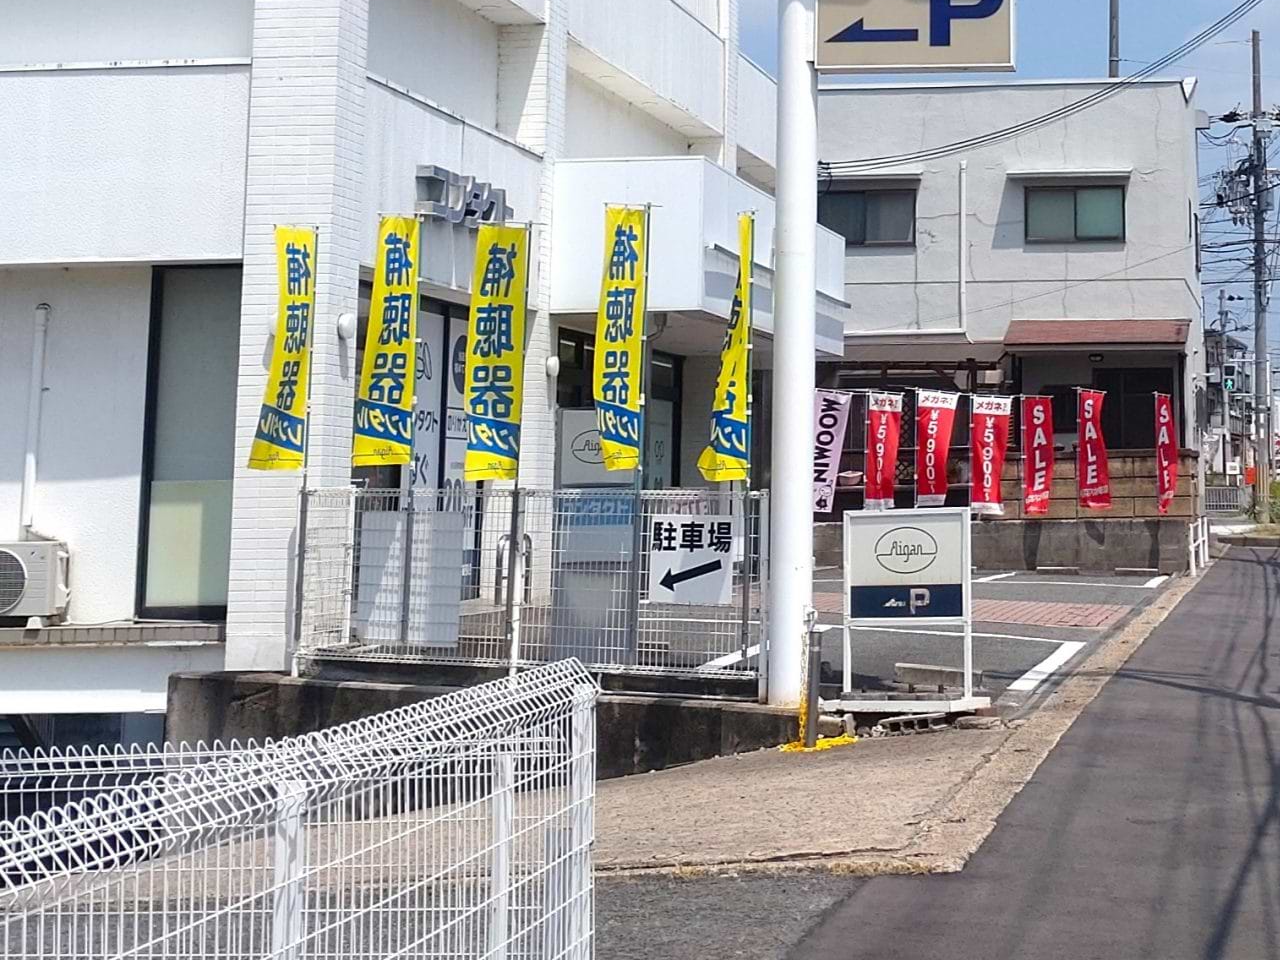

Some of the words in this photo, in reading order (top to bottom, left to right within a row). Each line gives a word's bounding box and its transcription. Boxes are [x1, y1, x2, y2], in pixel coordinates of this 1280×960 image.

[872, 397, 895, 409] メガネ
[976, 400, 1003, 410] メガネ
[813, 397, 842, 483] MOOMIN
[1032, 405, 1047, 491] SALE
[1083, 399, 1098, 484] SALE
[1158, 404, 1170, 489] SALE
[651, 521, 732, 554] 駐車場
[890, 540, 923, 563] Aigan
[909, 587, 930, 615] P
